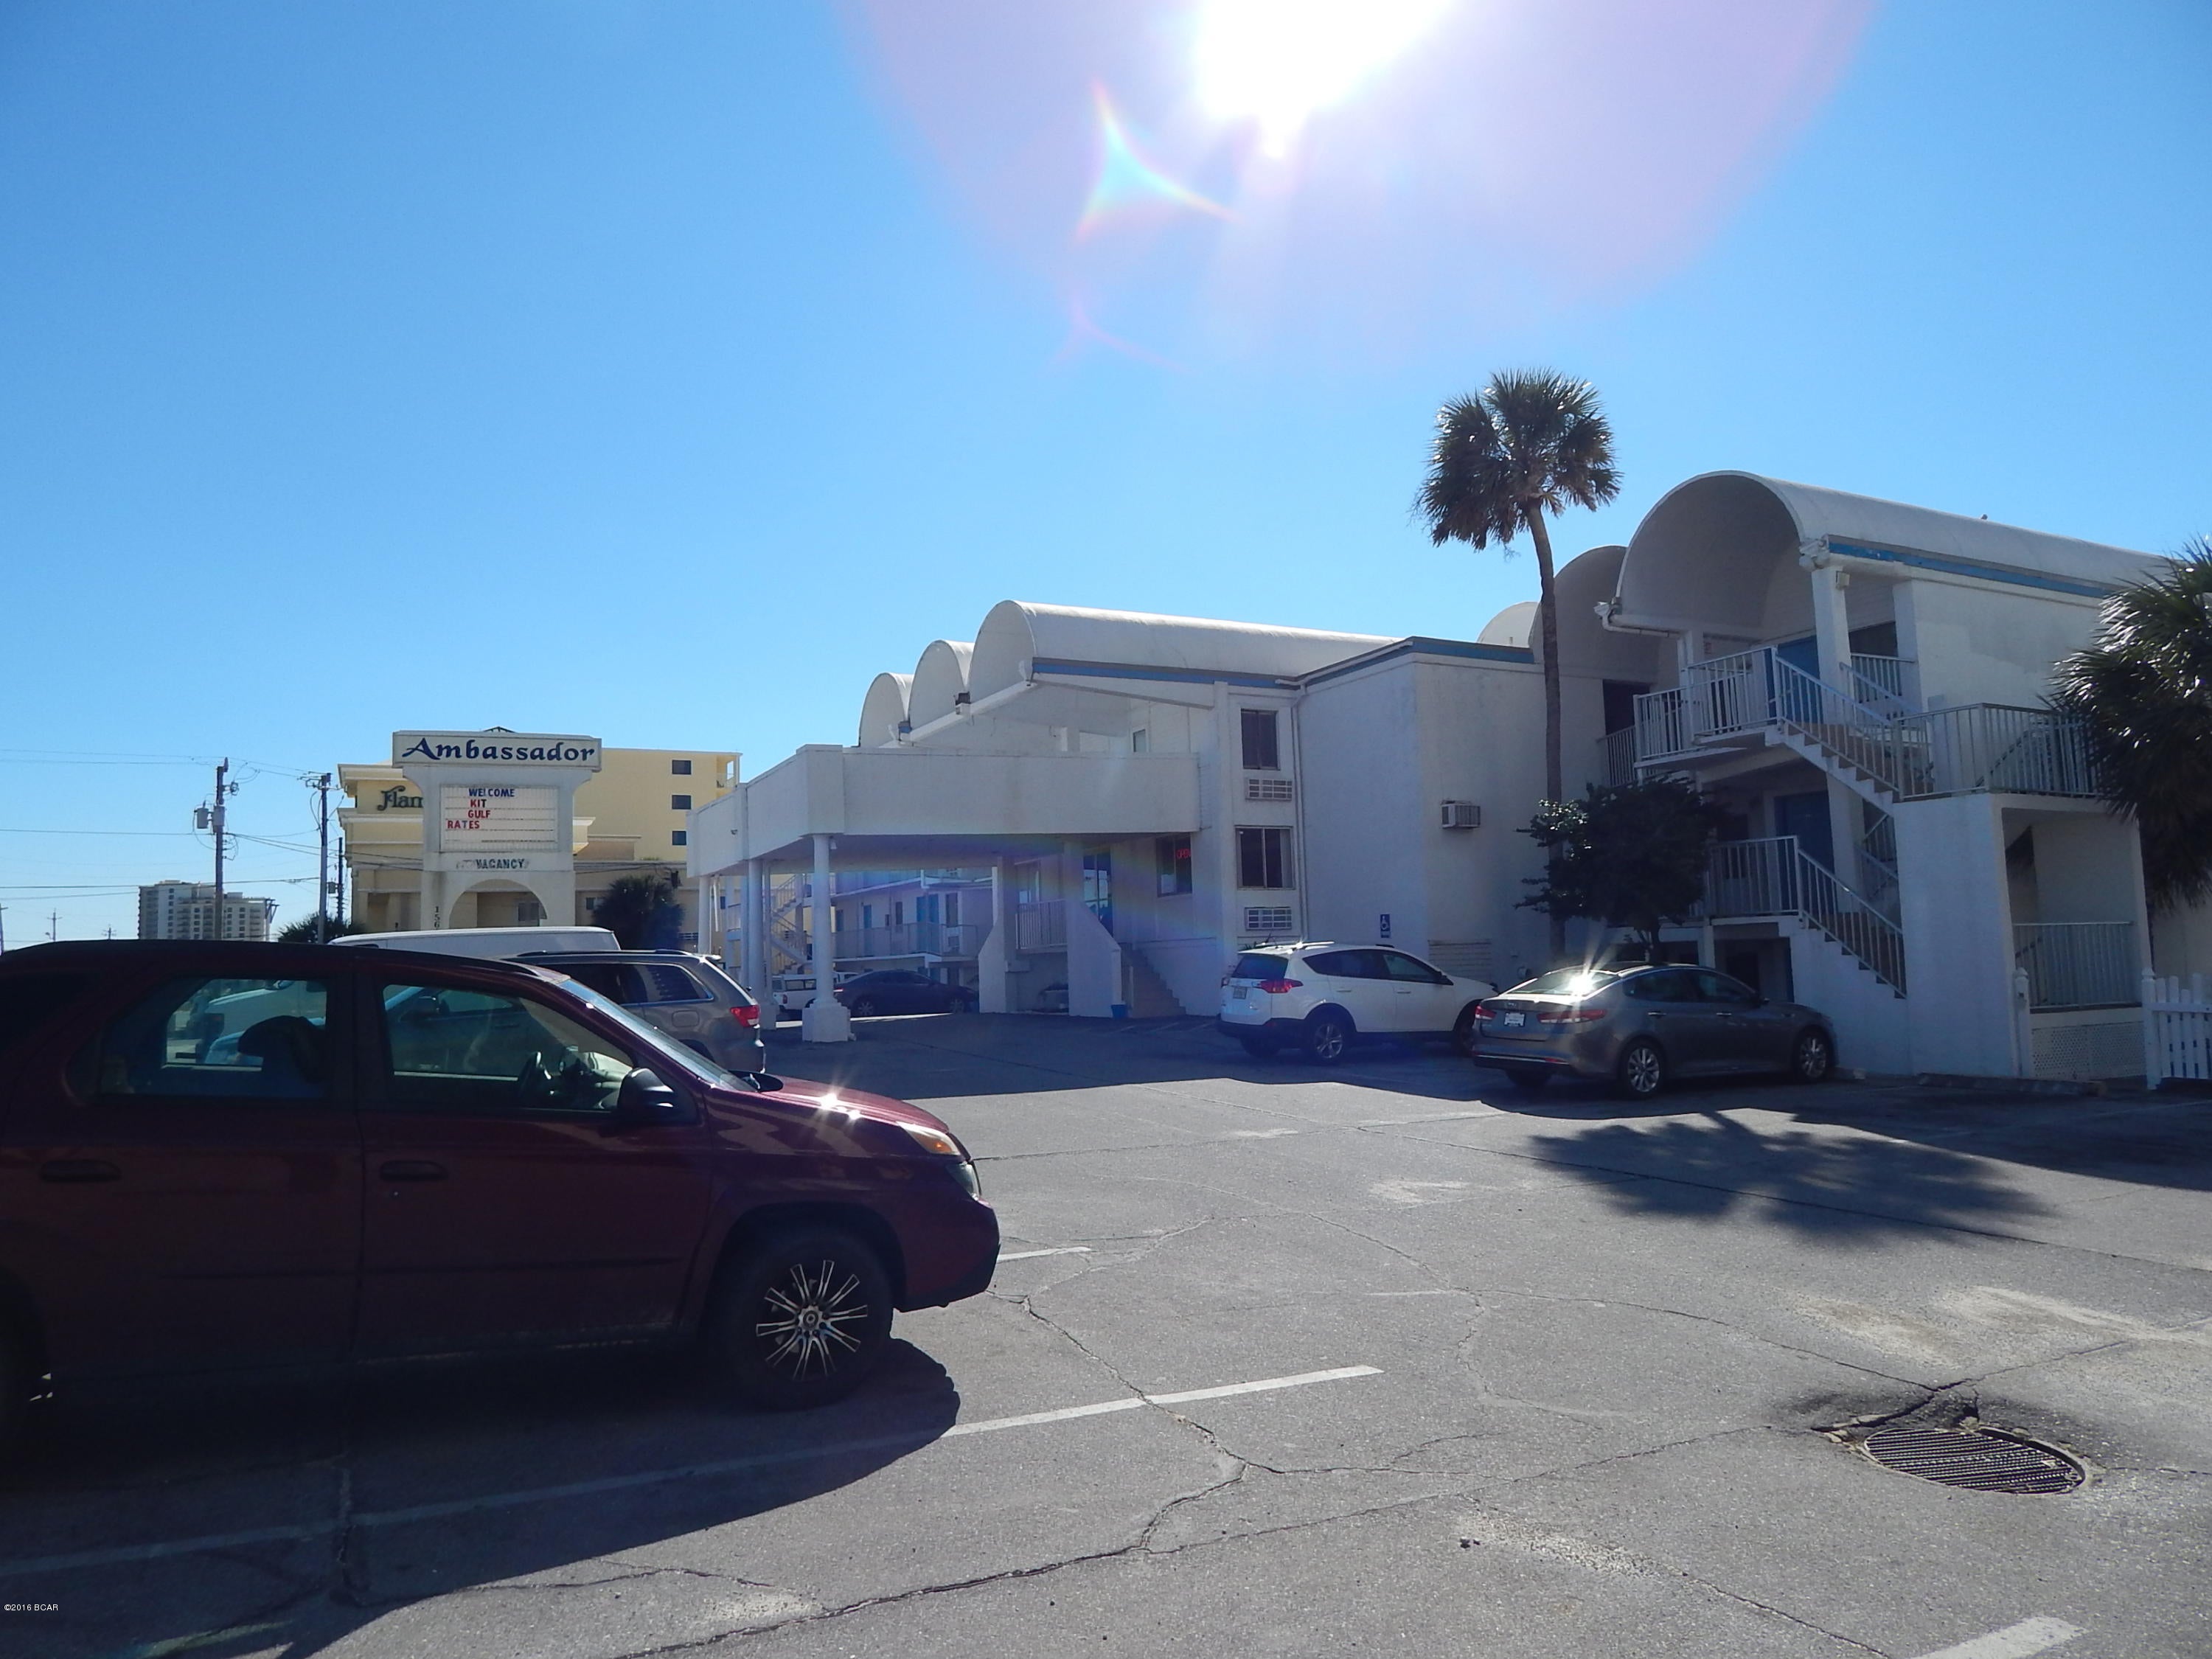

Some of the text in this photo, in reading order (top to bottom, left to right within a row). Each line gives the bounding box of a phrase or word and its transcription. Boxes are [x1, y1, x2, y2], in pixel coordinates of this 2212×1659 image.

[402, 737, 594, 761] Ambassador
[470, 799, 487, 807] KIT
[468, 810, 490, 818] GULF
[448, 821, 479, 829] RATES
[476, 858, 524, 869] VACANCY
